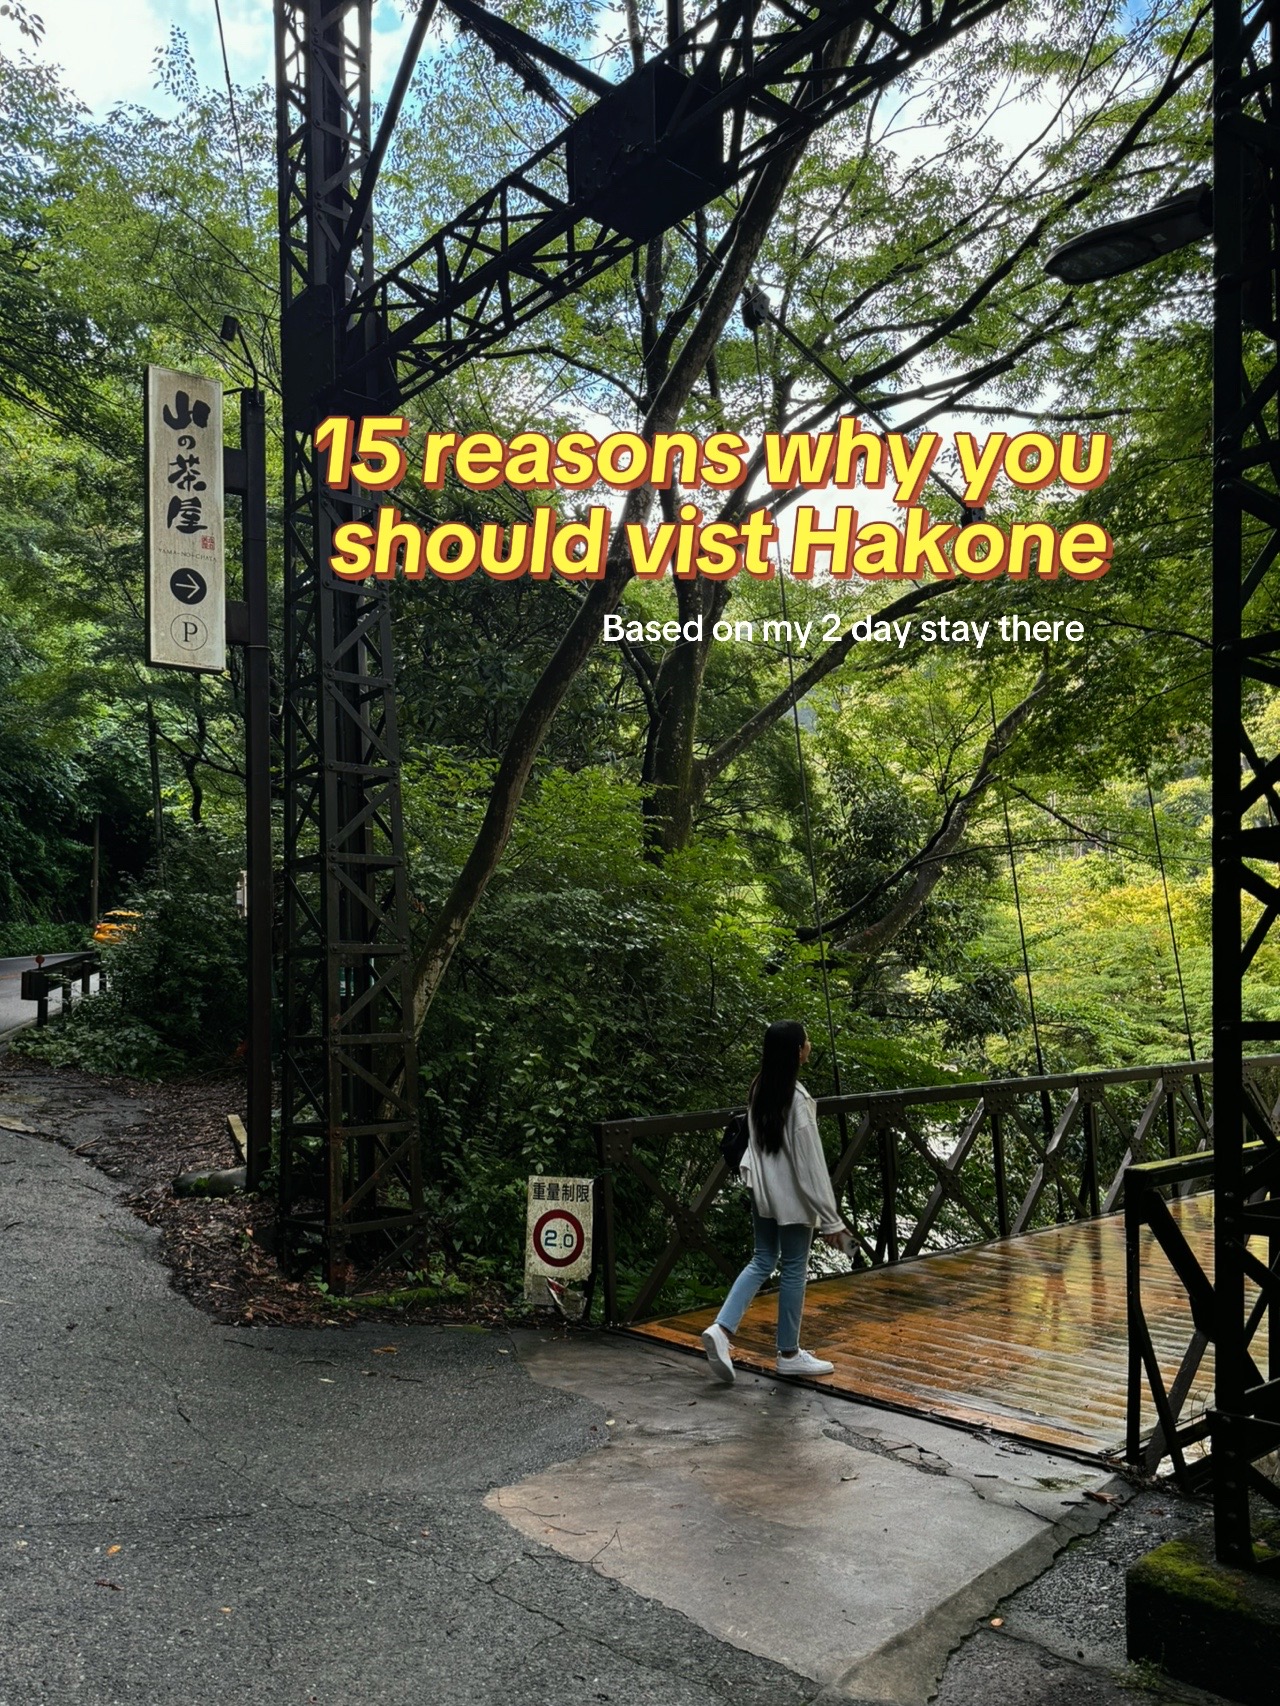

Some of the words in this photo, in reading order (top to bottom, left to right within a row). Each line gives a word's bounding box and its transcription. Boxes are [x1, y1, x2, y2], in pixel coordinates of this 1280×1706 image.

[163, 389, 212, 534] 山の茶屋
[182, 621, 198, 643] P
[532, 1181, 590, 1203] 重量制限
